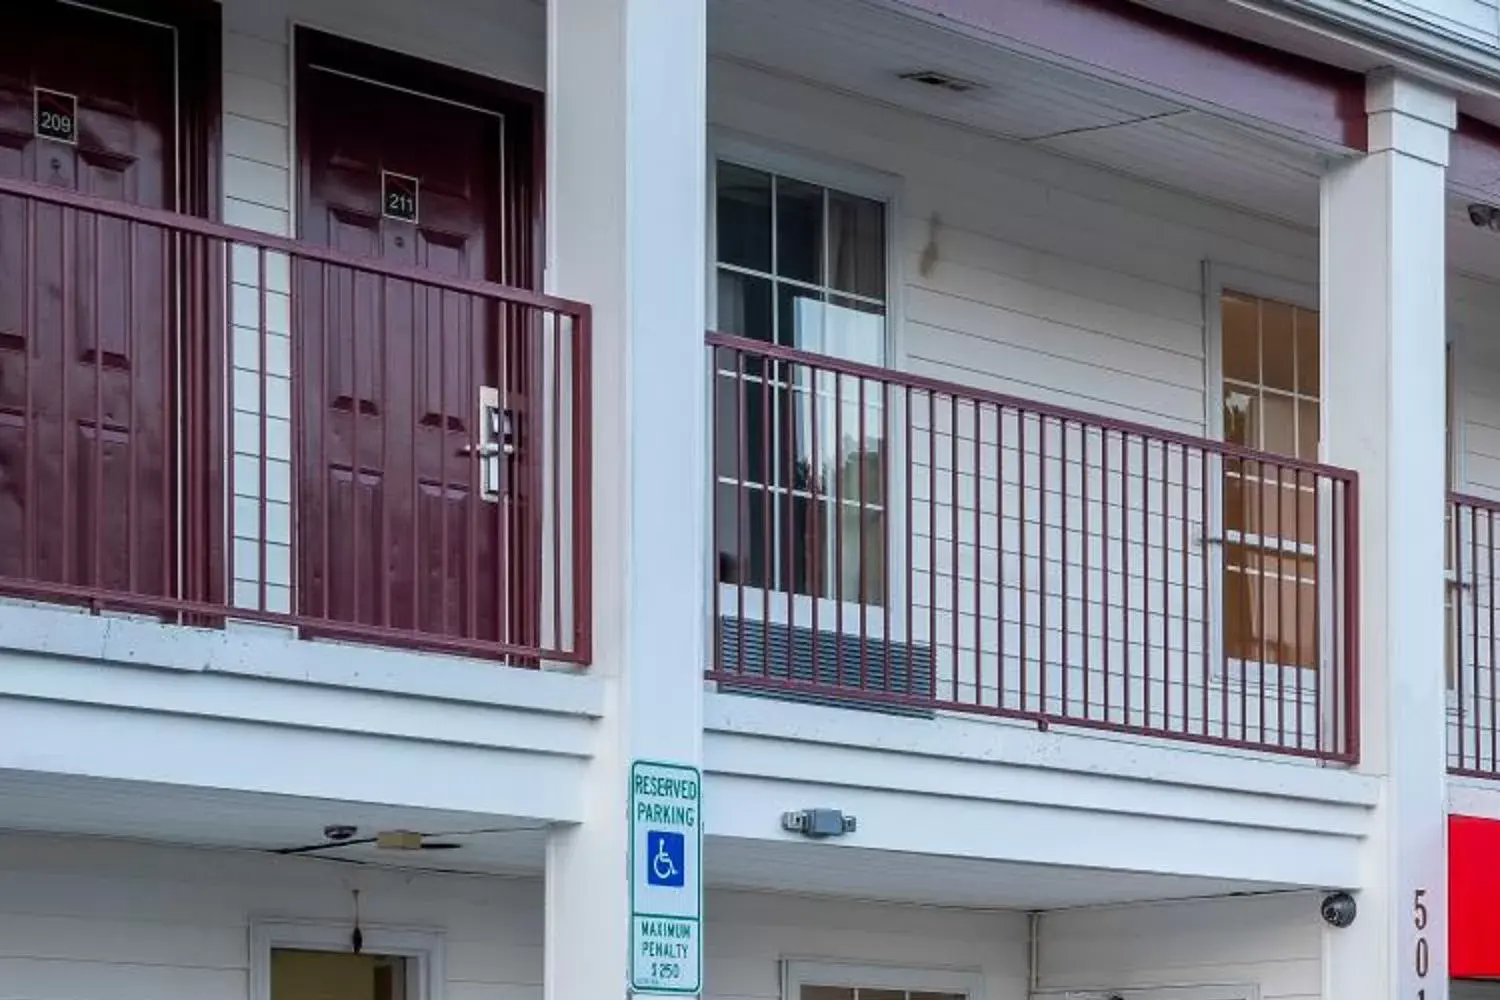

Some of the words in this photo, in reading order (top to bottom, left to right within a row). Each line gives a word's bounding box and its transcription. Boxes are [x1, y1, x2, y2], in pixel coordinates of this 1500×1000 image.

[40, 111, 71, 133] 209
[389, 192, 413, 213] 211
[635, 774, 697, 801] RESERVED
[637, 801, 695, 827] PARKING
[641, 920, 691, 939] MAXIMUM
[641, 941, 689, 959] PENALTY
